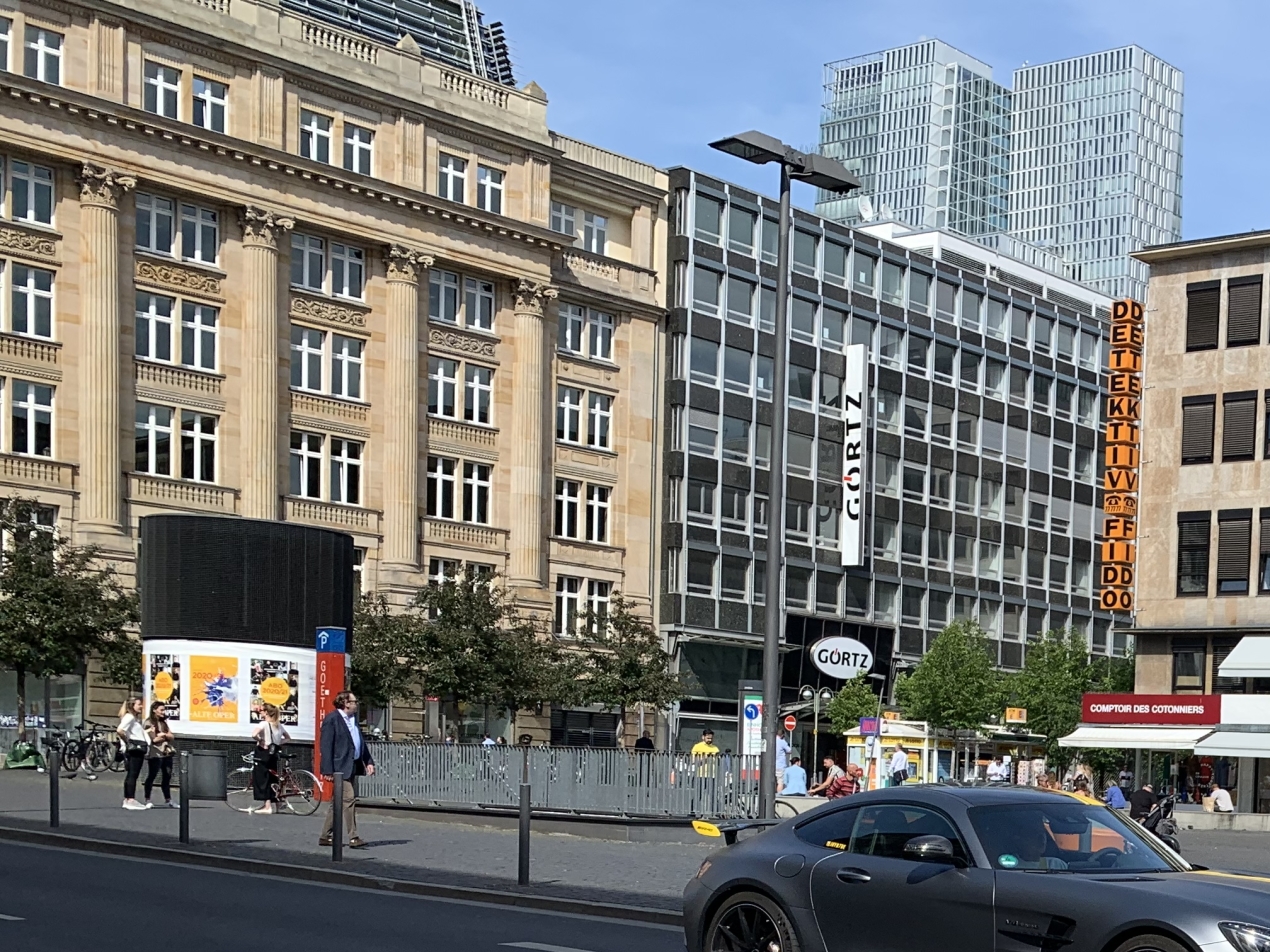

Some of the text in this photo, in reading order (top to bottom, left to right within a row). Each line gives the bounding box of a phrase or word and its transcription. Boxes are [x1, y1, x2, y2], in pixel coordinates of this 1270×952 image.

[1107, 302, 1128, 488] DETEKTIV
[1125, 302, 1143, 490] DETEKTIV
[1103, 519, 1119, 608] FIDO
[1120, 521, 1134, 609] FIDO
[1090, 704, 1205, 714] COMPTOIR DES COTONNIERS
